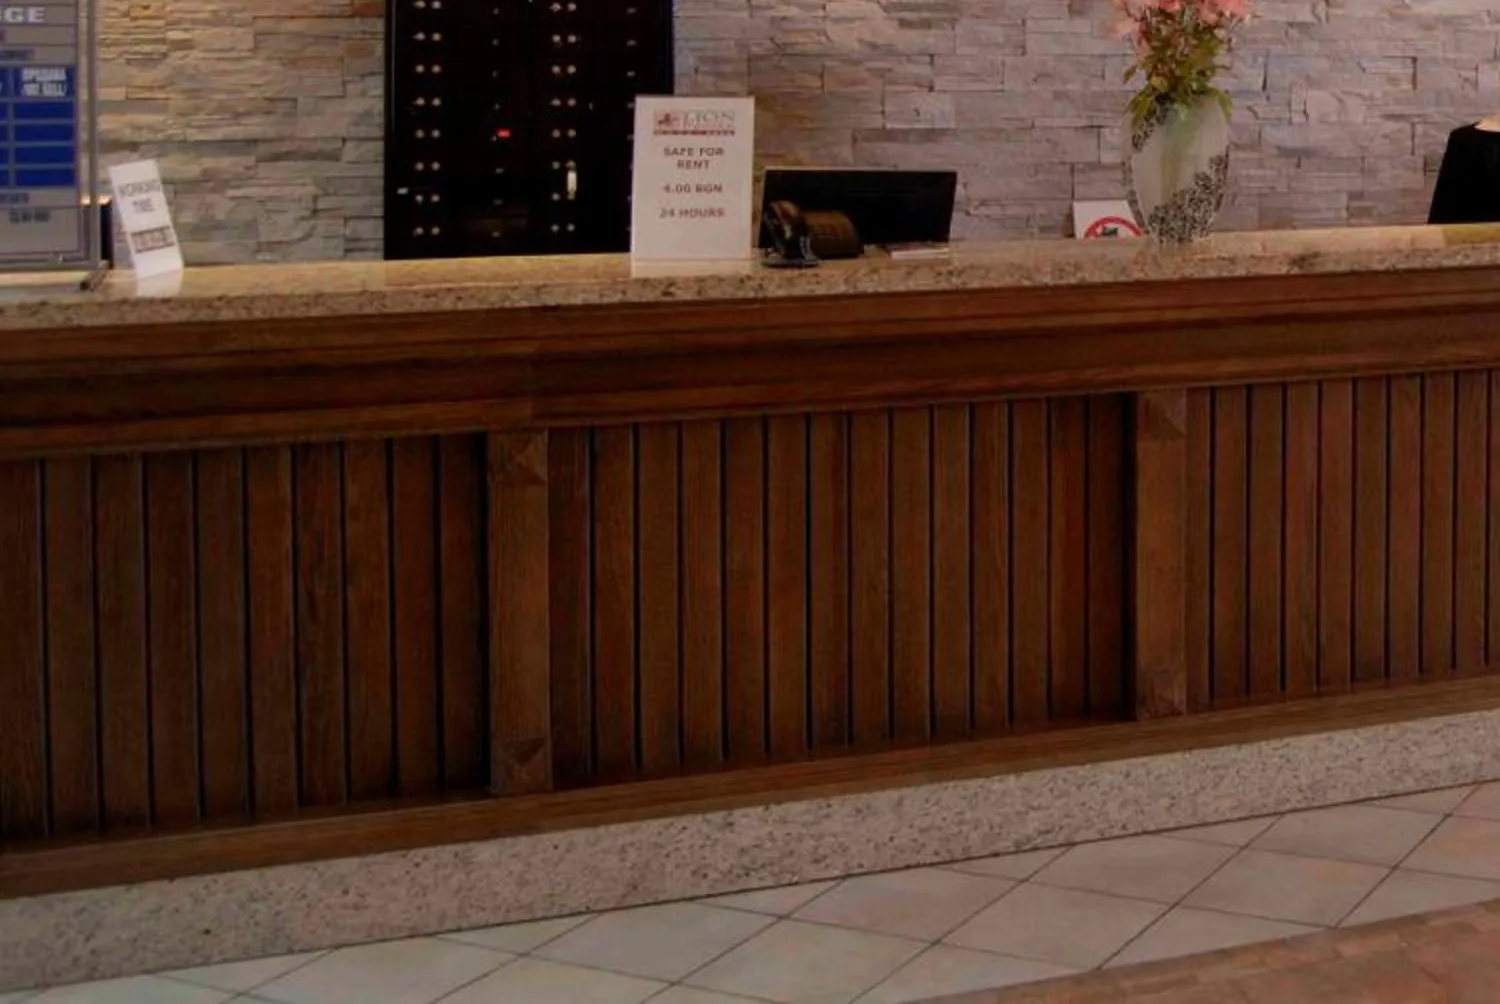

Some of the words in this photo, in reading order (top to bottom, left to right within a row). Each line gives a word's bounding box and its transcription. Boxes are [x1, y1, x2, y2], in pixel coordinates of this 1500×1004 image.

[0, 6, 46, 23] GE
[664, 147, 694, 157] SAFE
[699, 147, 724, 157] FOR
[677, 159, 710, 170] RENT
[696, 183, 722, 194] BGN
[680, 207, 725, 218] HOURS
